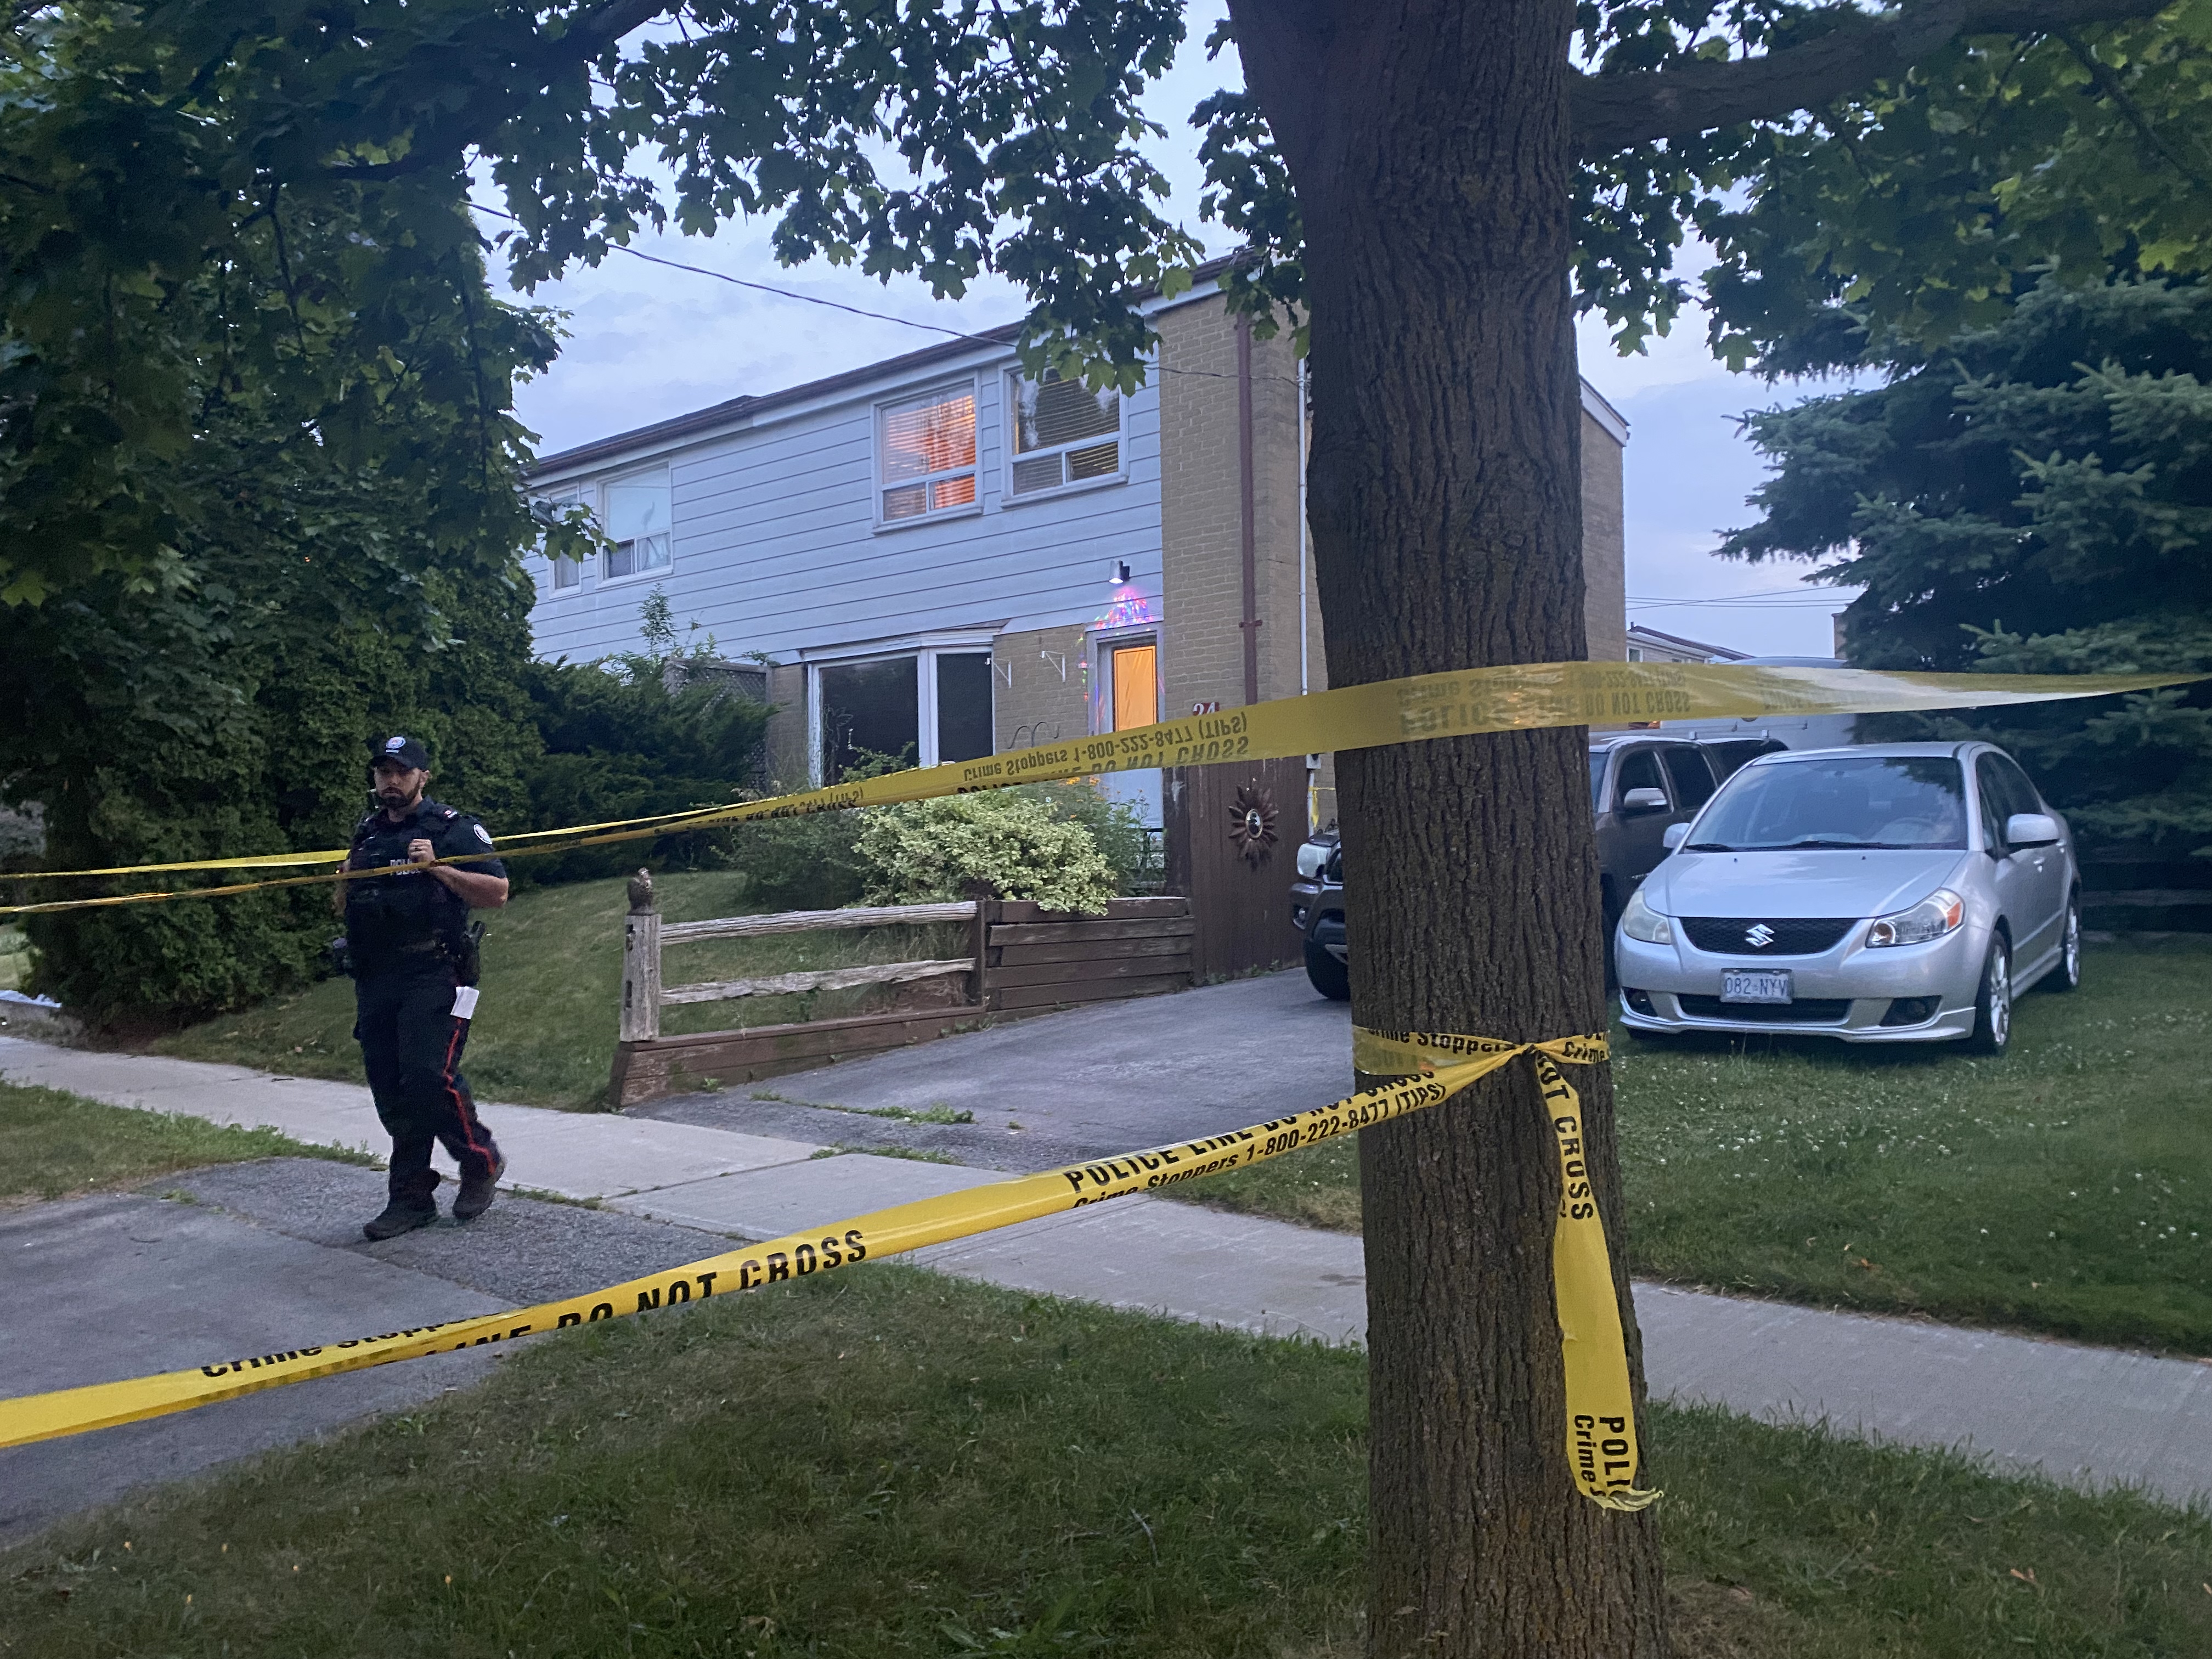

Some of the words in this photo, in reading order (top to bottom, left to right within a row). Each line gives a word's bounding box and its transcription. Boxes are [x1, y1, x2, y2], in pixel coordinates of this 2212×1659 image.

[1246, 1098, 1389, 1161] 1-800-222-8477
[1395, 1082, 1446, 1115] (TIPS)
[1063, 1150, 1180, 1193] POLICE
[636, 1272, 718, 1313] NOT
[739, 1229, 867, 1290] CROSS
[1574, 1414, 1596, 1483] Crime
